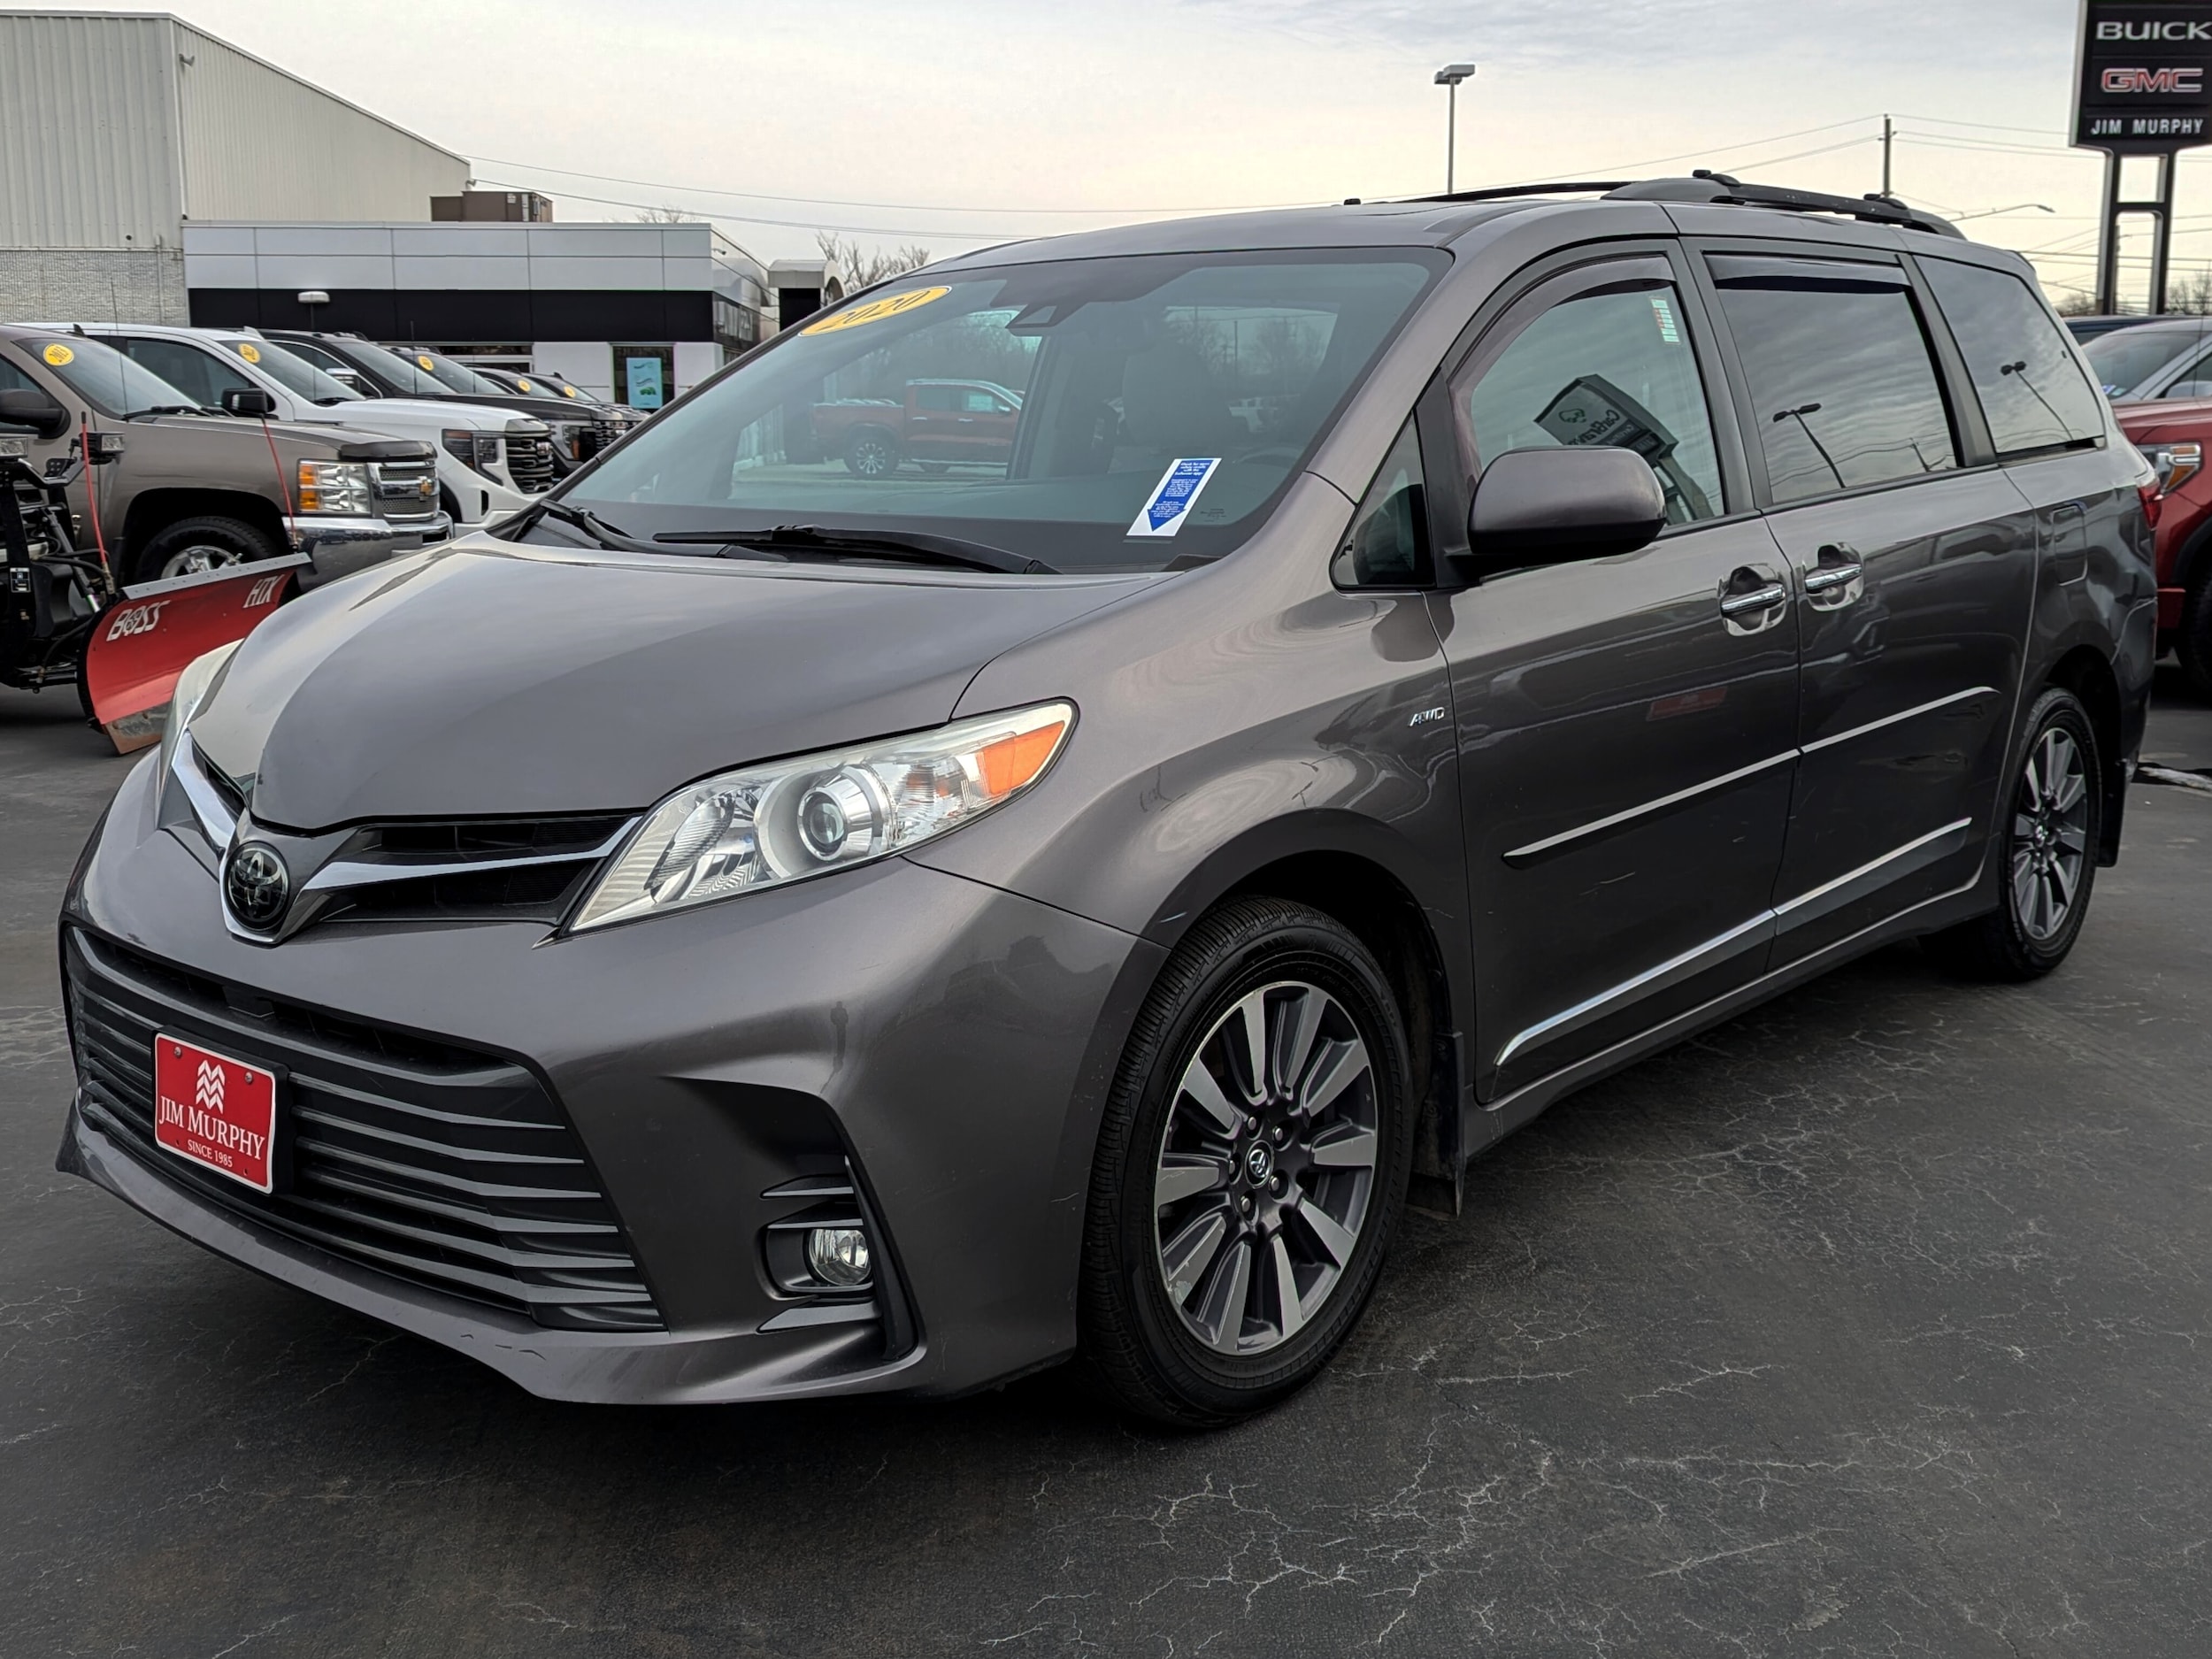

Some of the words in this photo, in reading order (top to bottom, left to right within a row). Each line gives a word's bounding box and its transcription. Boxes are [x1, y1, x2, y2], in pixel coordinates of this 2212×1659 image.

[2096, 21, 2212, 40] BUICK
[2101, 68, 2203, 93] GMC
[2090, 119, 2122, 134] JIM
[2132, 119, 2203, 134] MURPHY
[815, 290, 931, 332] 2020
[106, 600, 171, 641] BOSS
[1409, 707, 1445, 726] AWD
[159, 1095, 184, 1128] JIM
[188, 1106, 265, 1160] MURPHY
[188, 1140, 212, 1159] SINCE
[214, 1150, 233, 1167] 1985
